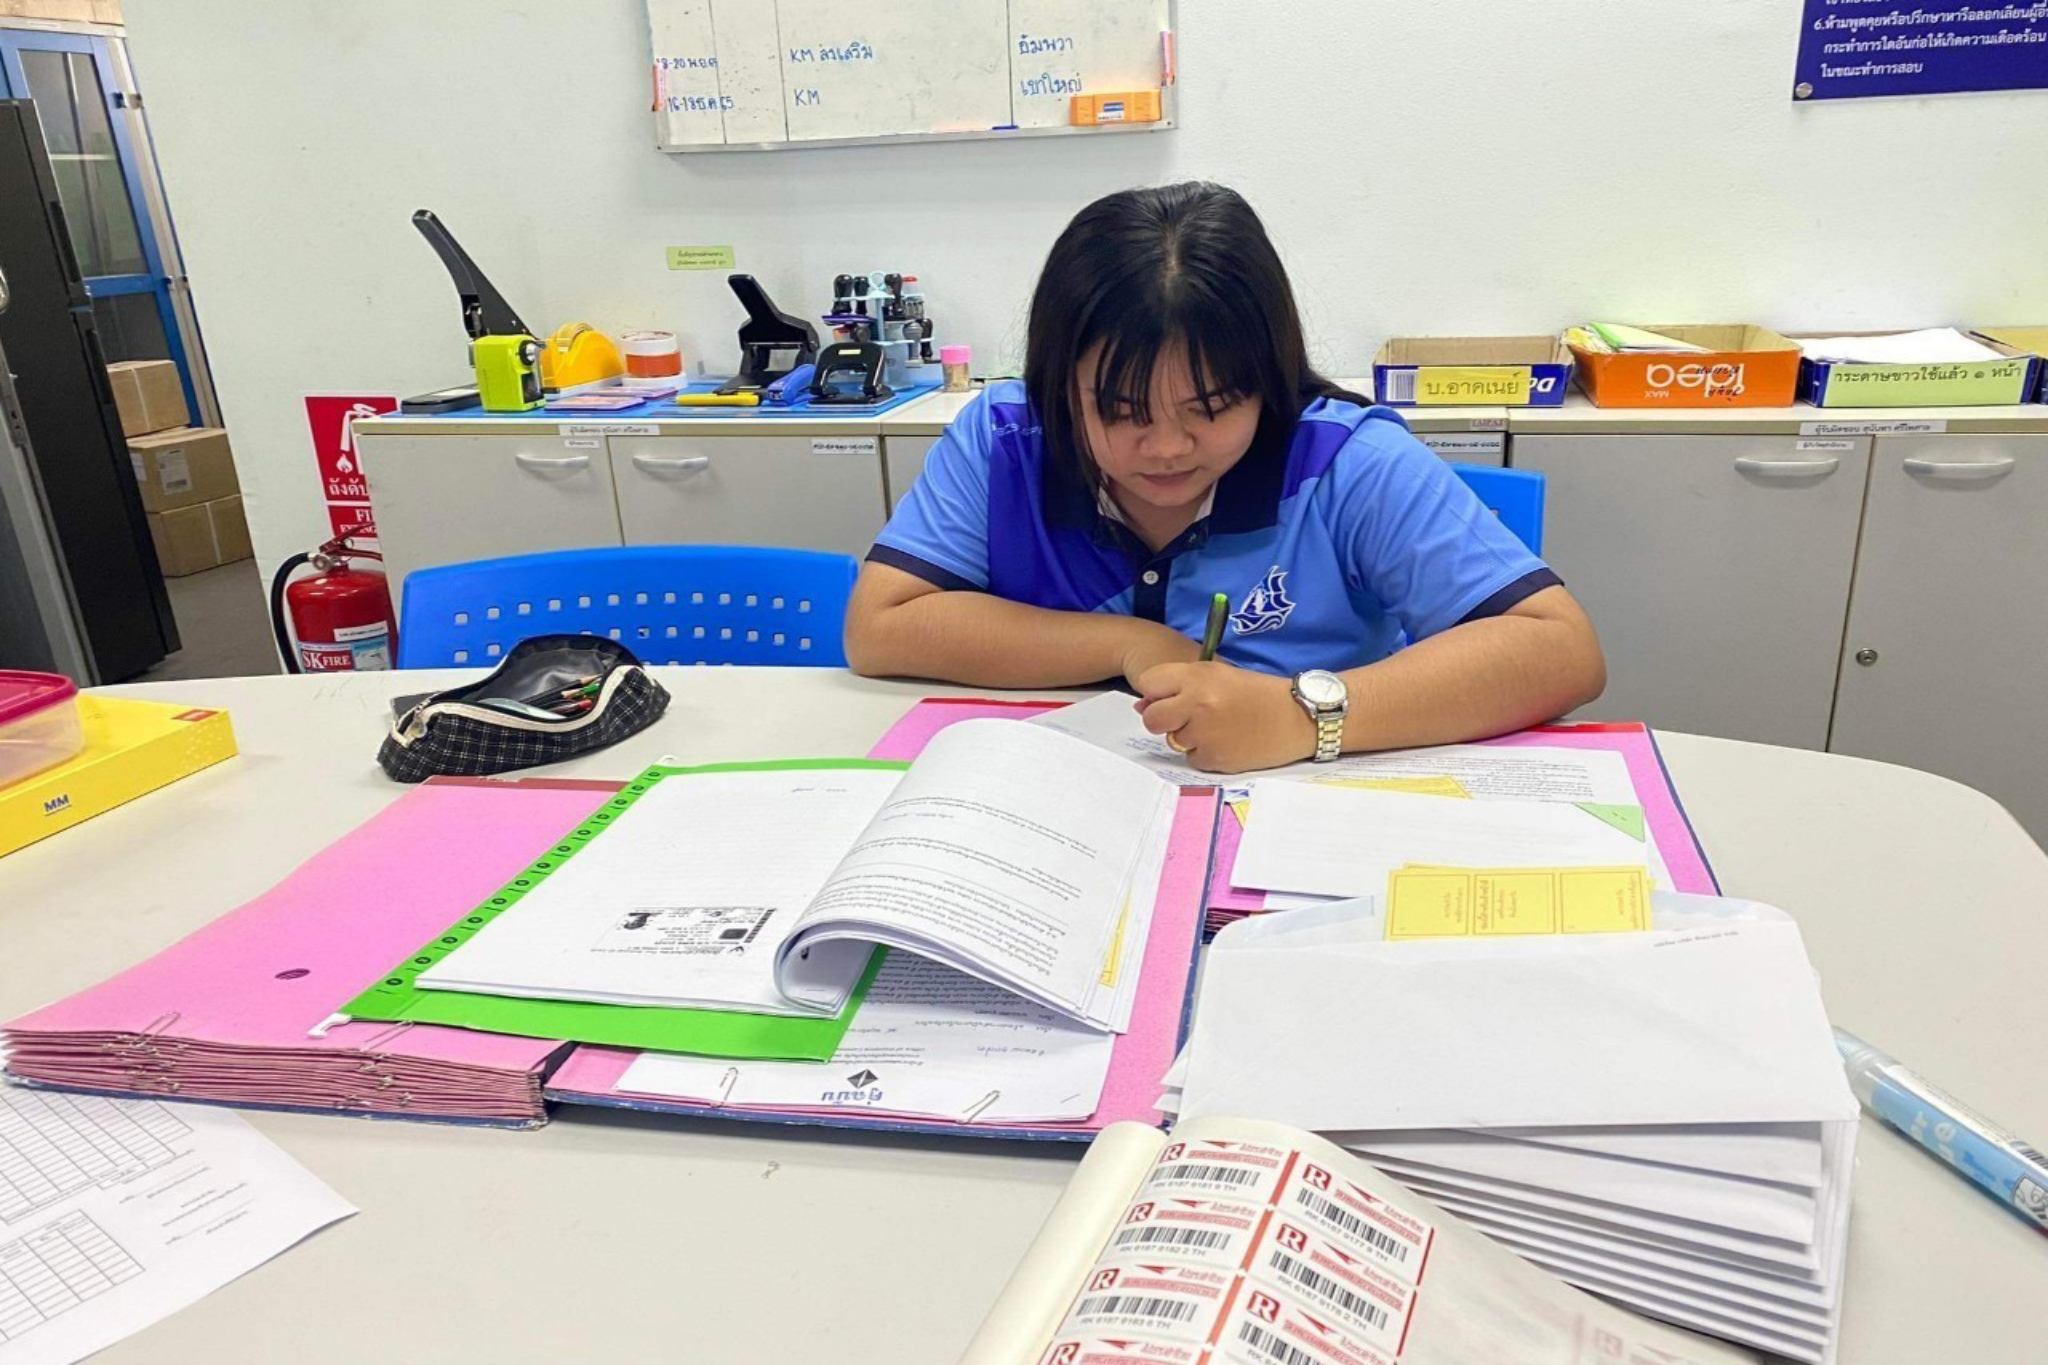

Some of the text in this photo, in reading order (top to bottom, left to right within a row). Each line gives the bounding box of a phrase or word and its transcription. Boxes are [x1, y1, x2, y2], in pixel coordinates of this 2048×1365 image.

[790, 48, 815, 63] KM
[794, 88, 820, 106] KM
[1992, 363, 2021, 378] หน้า
[1426, 371, 1522, 395] บ.อาคเนย์
[1645, 390, 1669, 398] MAX
[302, 651, 325, 669] SK
[44, 793, 70, 813] MM
[821, 1087, 883, 1105] คู่ฉบับ
[1160, 1144, 1184, 1162] R
[1303, 1164, 1331, 1190] R
[1127, 1203, 1154, 1223] R
[1277, 1223, 1307, 1253] R
[1192, 1249, 1206, 1257] TH
[1090, 1268, 1119, 1291] R
[1247, 1290, 1280, 1324] R
[1156, 1320, 1171, 1329] TH
[1353, 1318, 1367, 1330] TH
[1050, 1343, 1080, 1365] R
